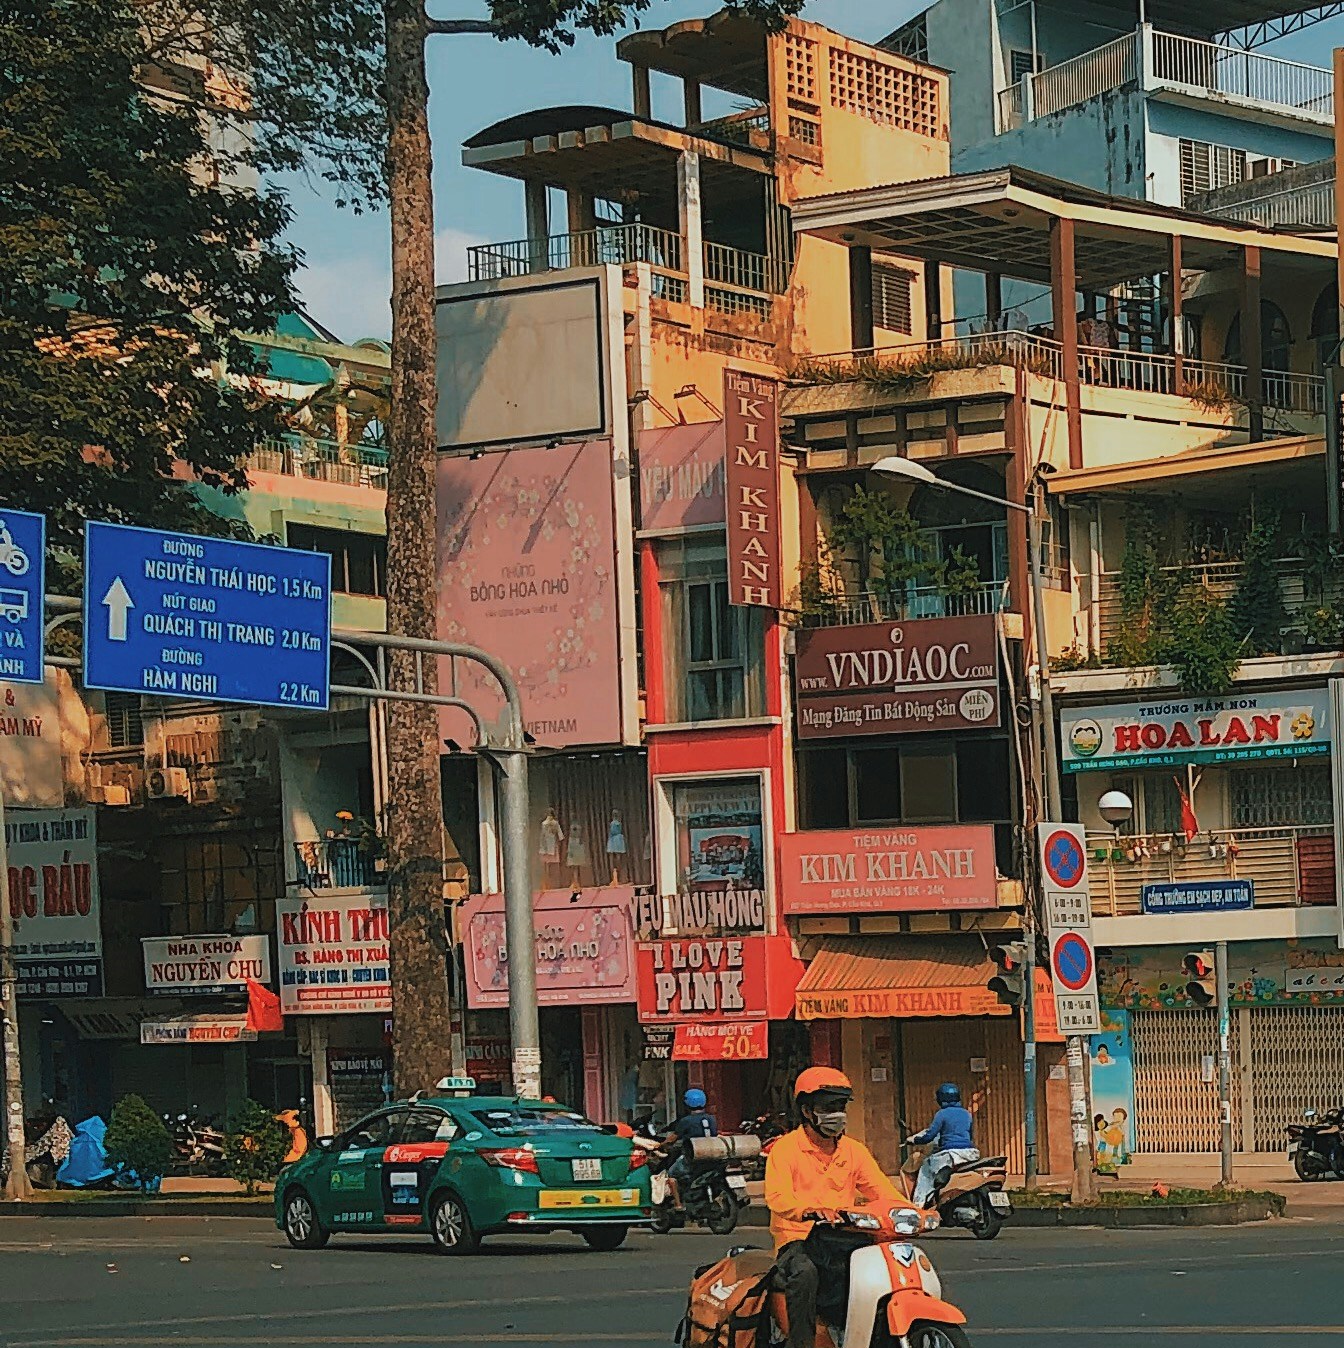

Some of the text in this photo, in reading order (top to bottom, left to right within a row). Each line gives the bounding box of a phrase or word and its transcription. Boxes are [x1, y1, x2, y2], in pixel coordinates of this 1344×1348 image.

[727, 373, 774, 403] Tiệm Vàng
[735, 396, 770, 470] KIM
[641, 459, 674, 503] YÊU
[678, 452, 713, 501] MÀU
[163, 539, 204, 558] ĐƯỜNG
[738, 486, 771, 606] KHANH
[145, 558, 205, 586] NGUYỄN
[210, 566, 243, 590] THÁI
[247, 573, 276, 597] HỌC
[303, 578, 322, 600] Km
[510, 581, 537, 598] HOA
[542, 573, 569, 595] NHỎ
[163, 591, 216, 612] NÚT GIAO
[5, 628, 25, 649] VÀ
[143, 611, 194, 638] QUÁCH
[198, 620, 222, 644] THỊ
[227, 623, 275, 646] TRANG
[302, 633, 321, 651] Km
[162, 648, 202, 666] ĐƯỜNG
[143, 665, 217, 693] HÀM NGHI
[301, 685, 319, 703] Km
[1139, 699, 1257, 717] TRƯỜNG MẦM NON
[22, 716, 42, 737] MỸ
[525, 718, 577, 736] VIETNAM
[803, 697, 956, 729] Mạng Đăng Tin Bất Động Sản
[969, 706, 986, 720] PHÍ
[1114, 714, 1281, 752] HOA LAN
[853, 833, 917, 849] TIỆM VÀNG
[800, 849, 976, 884] KIM KHANH
[631, 886, 663, 931] YÊU
[282, 902, 342, 945] KÍNH
[168, 940, 243, 956] NHA KHOA
[653, 940, 743, 969] I LOVE
[152, 955, 222, 983] NGUYỄN
[227, 959, 263, 981] CHU
[656, 970, 744, 1011] PINK
[853, 994, 890, 1014] KIM
[896, 991, 962, 1012] KHANH
